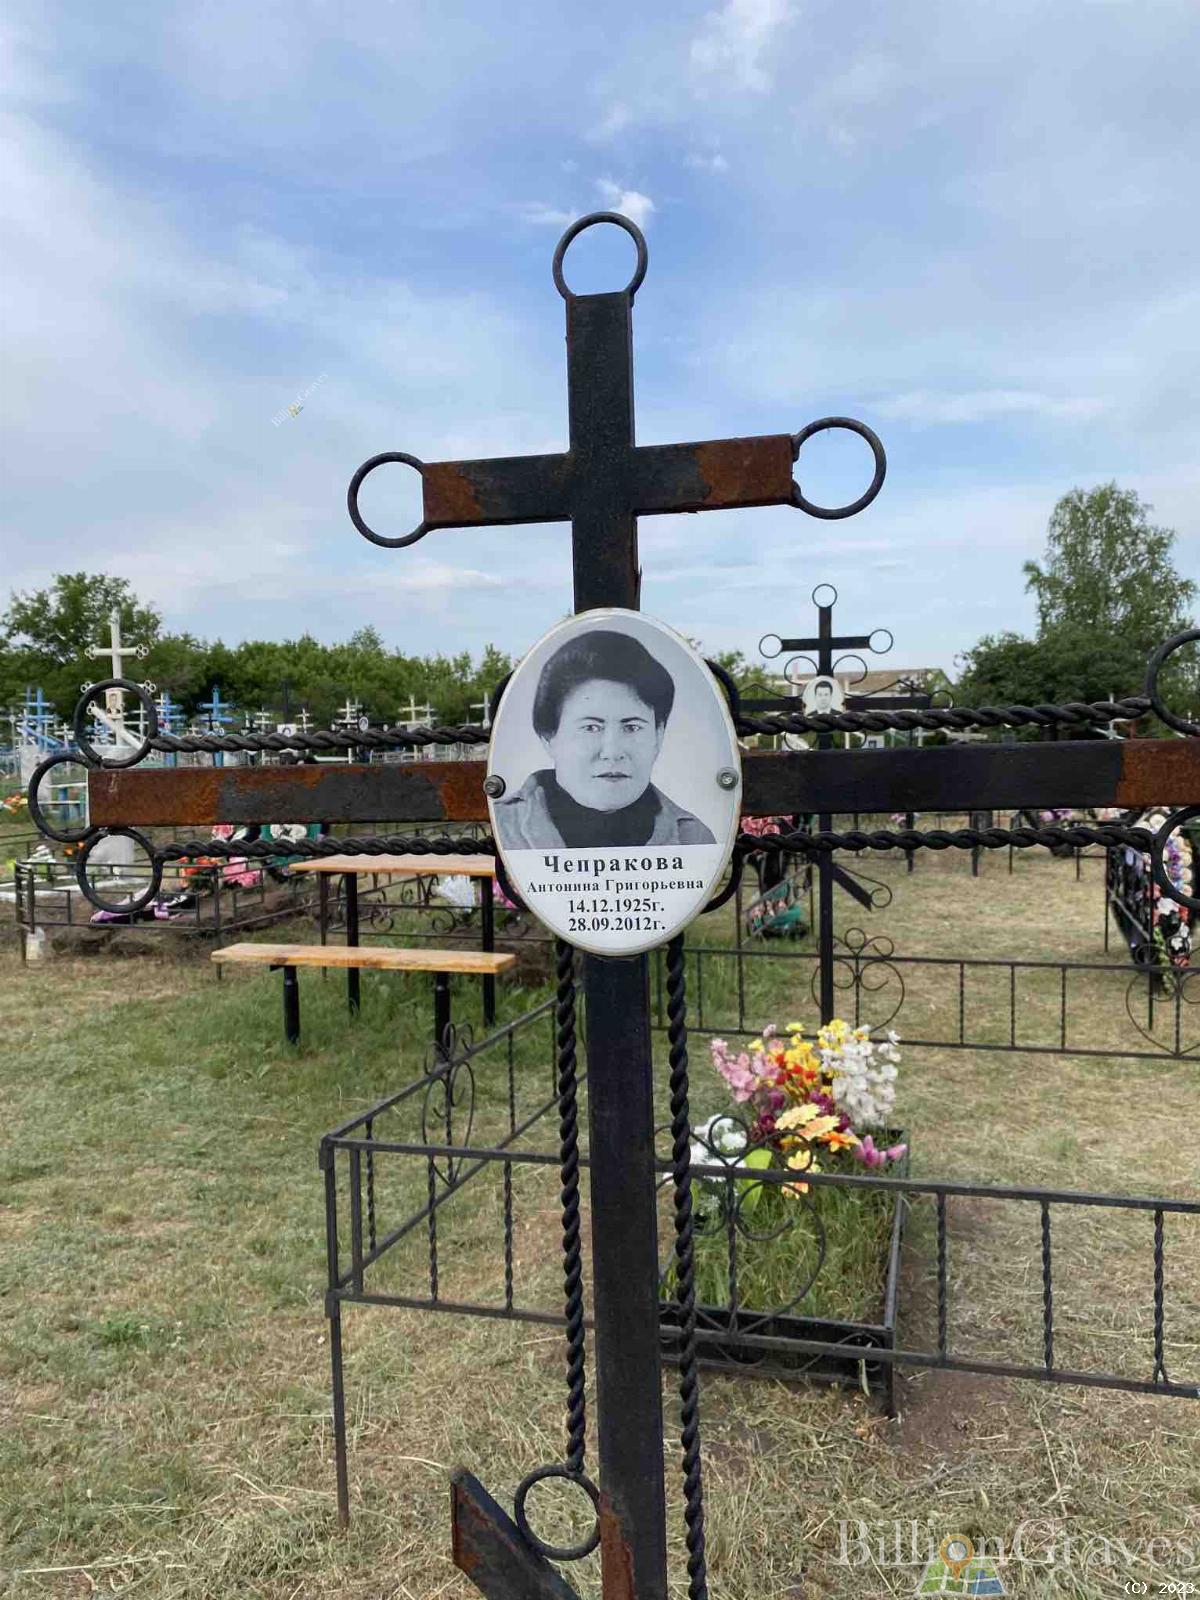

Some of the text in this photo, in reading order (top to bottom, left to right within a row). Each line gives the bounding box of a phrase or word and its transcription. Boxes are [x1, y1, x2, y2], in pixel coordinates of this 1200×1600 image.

[543, 855, 684, 877] Чепракова
[527, 879, 704, 893] Антонина Григорьевна
[568, 898, 665, 913] 14.12.1925г.
[568, 917, 666, 932] 28.09.2012г.
